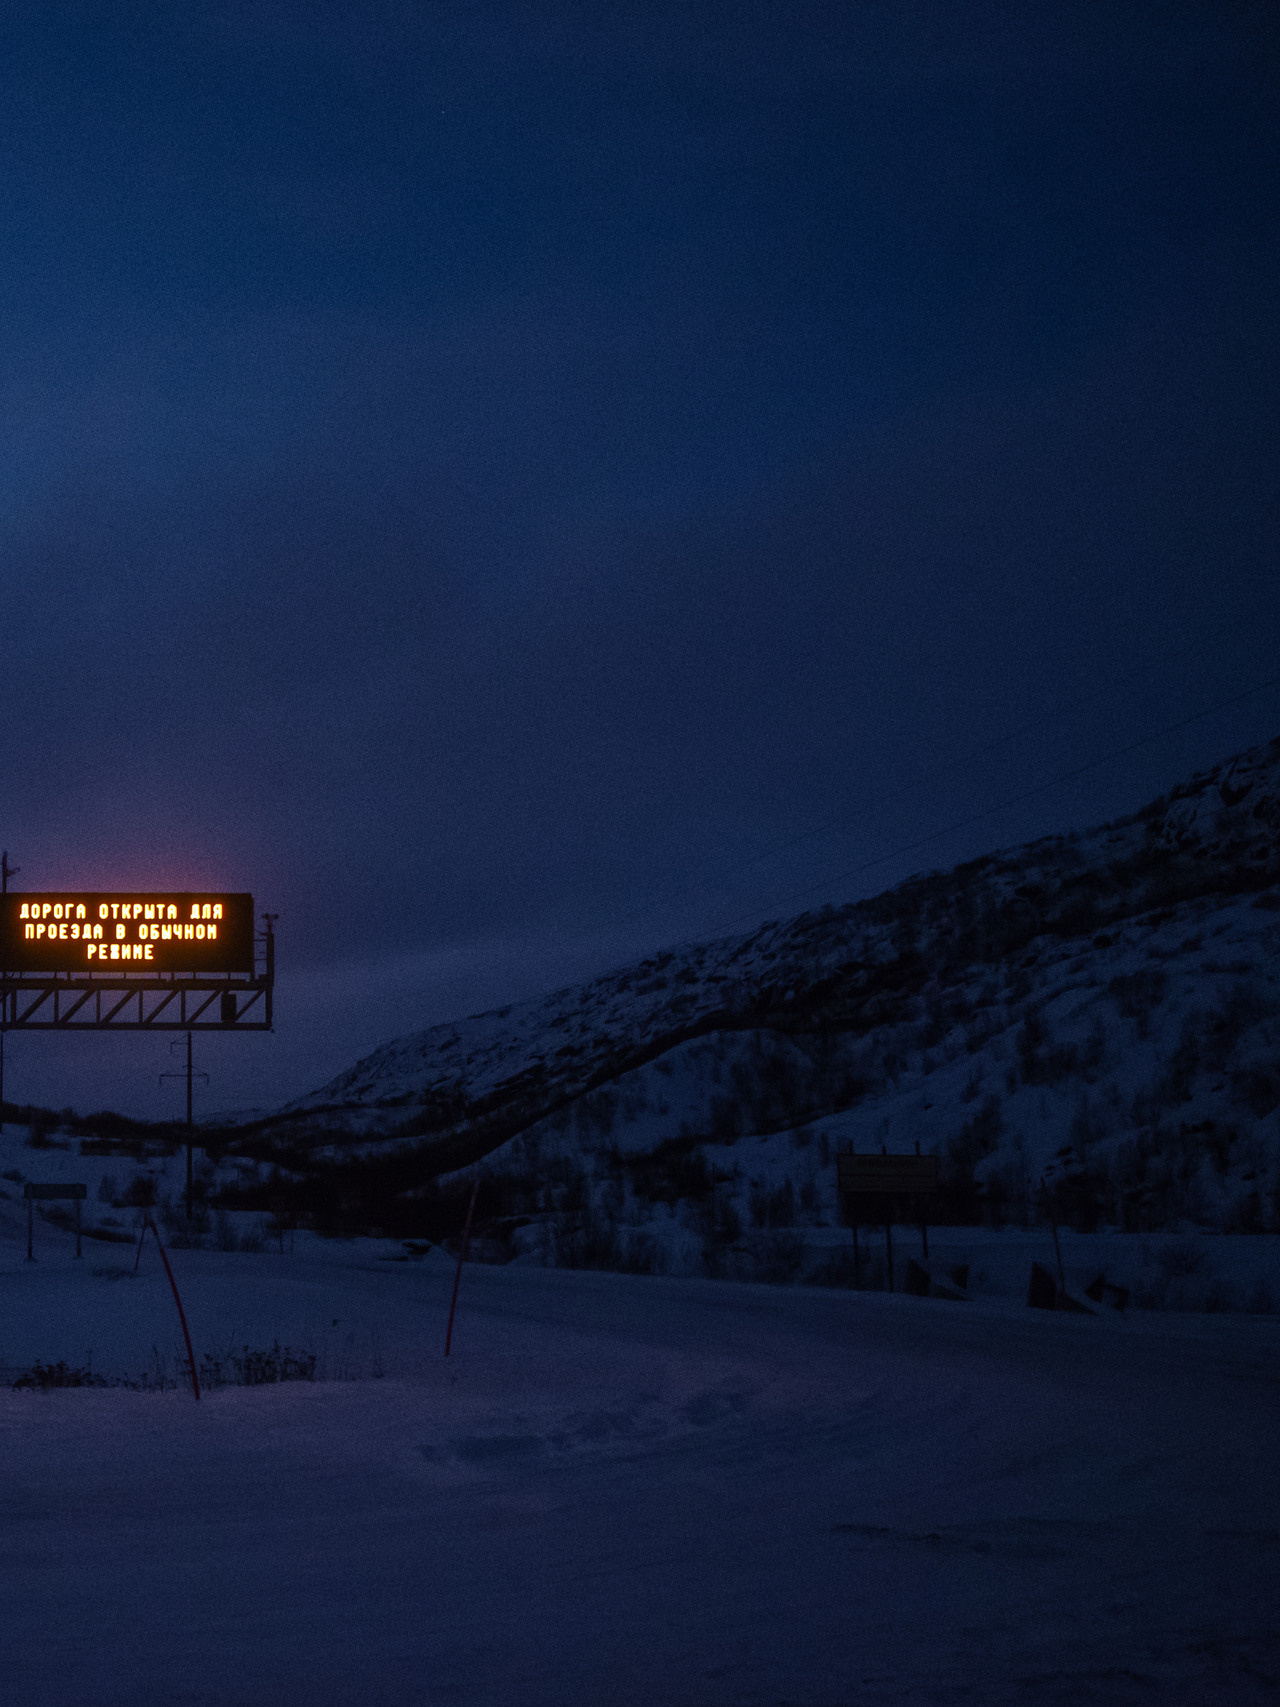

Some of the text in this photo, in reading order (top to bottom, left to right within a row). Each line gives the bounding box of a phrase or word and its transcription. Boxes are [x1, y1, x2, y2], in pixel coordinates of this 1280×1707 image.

[19, 903, 223, 919] ДОРОГА ОТКРЫТА ДЛЯ
[24, 923, 218, 940] ПРОЕЗДА В ОБЫЧНОМ
[87, 943, 154, 960] РЕЖИМЕ
